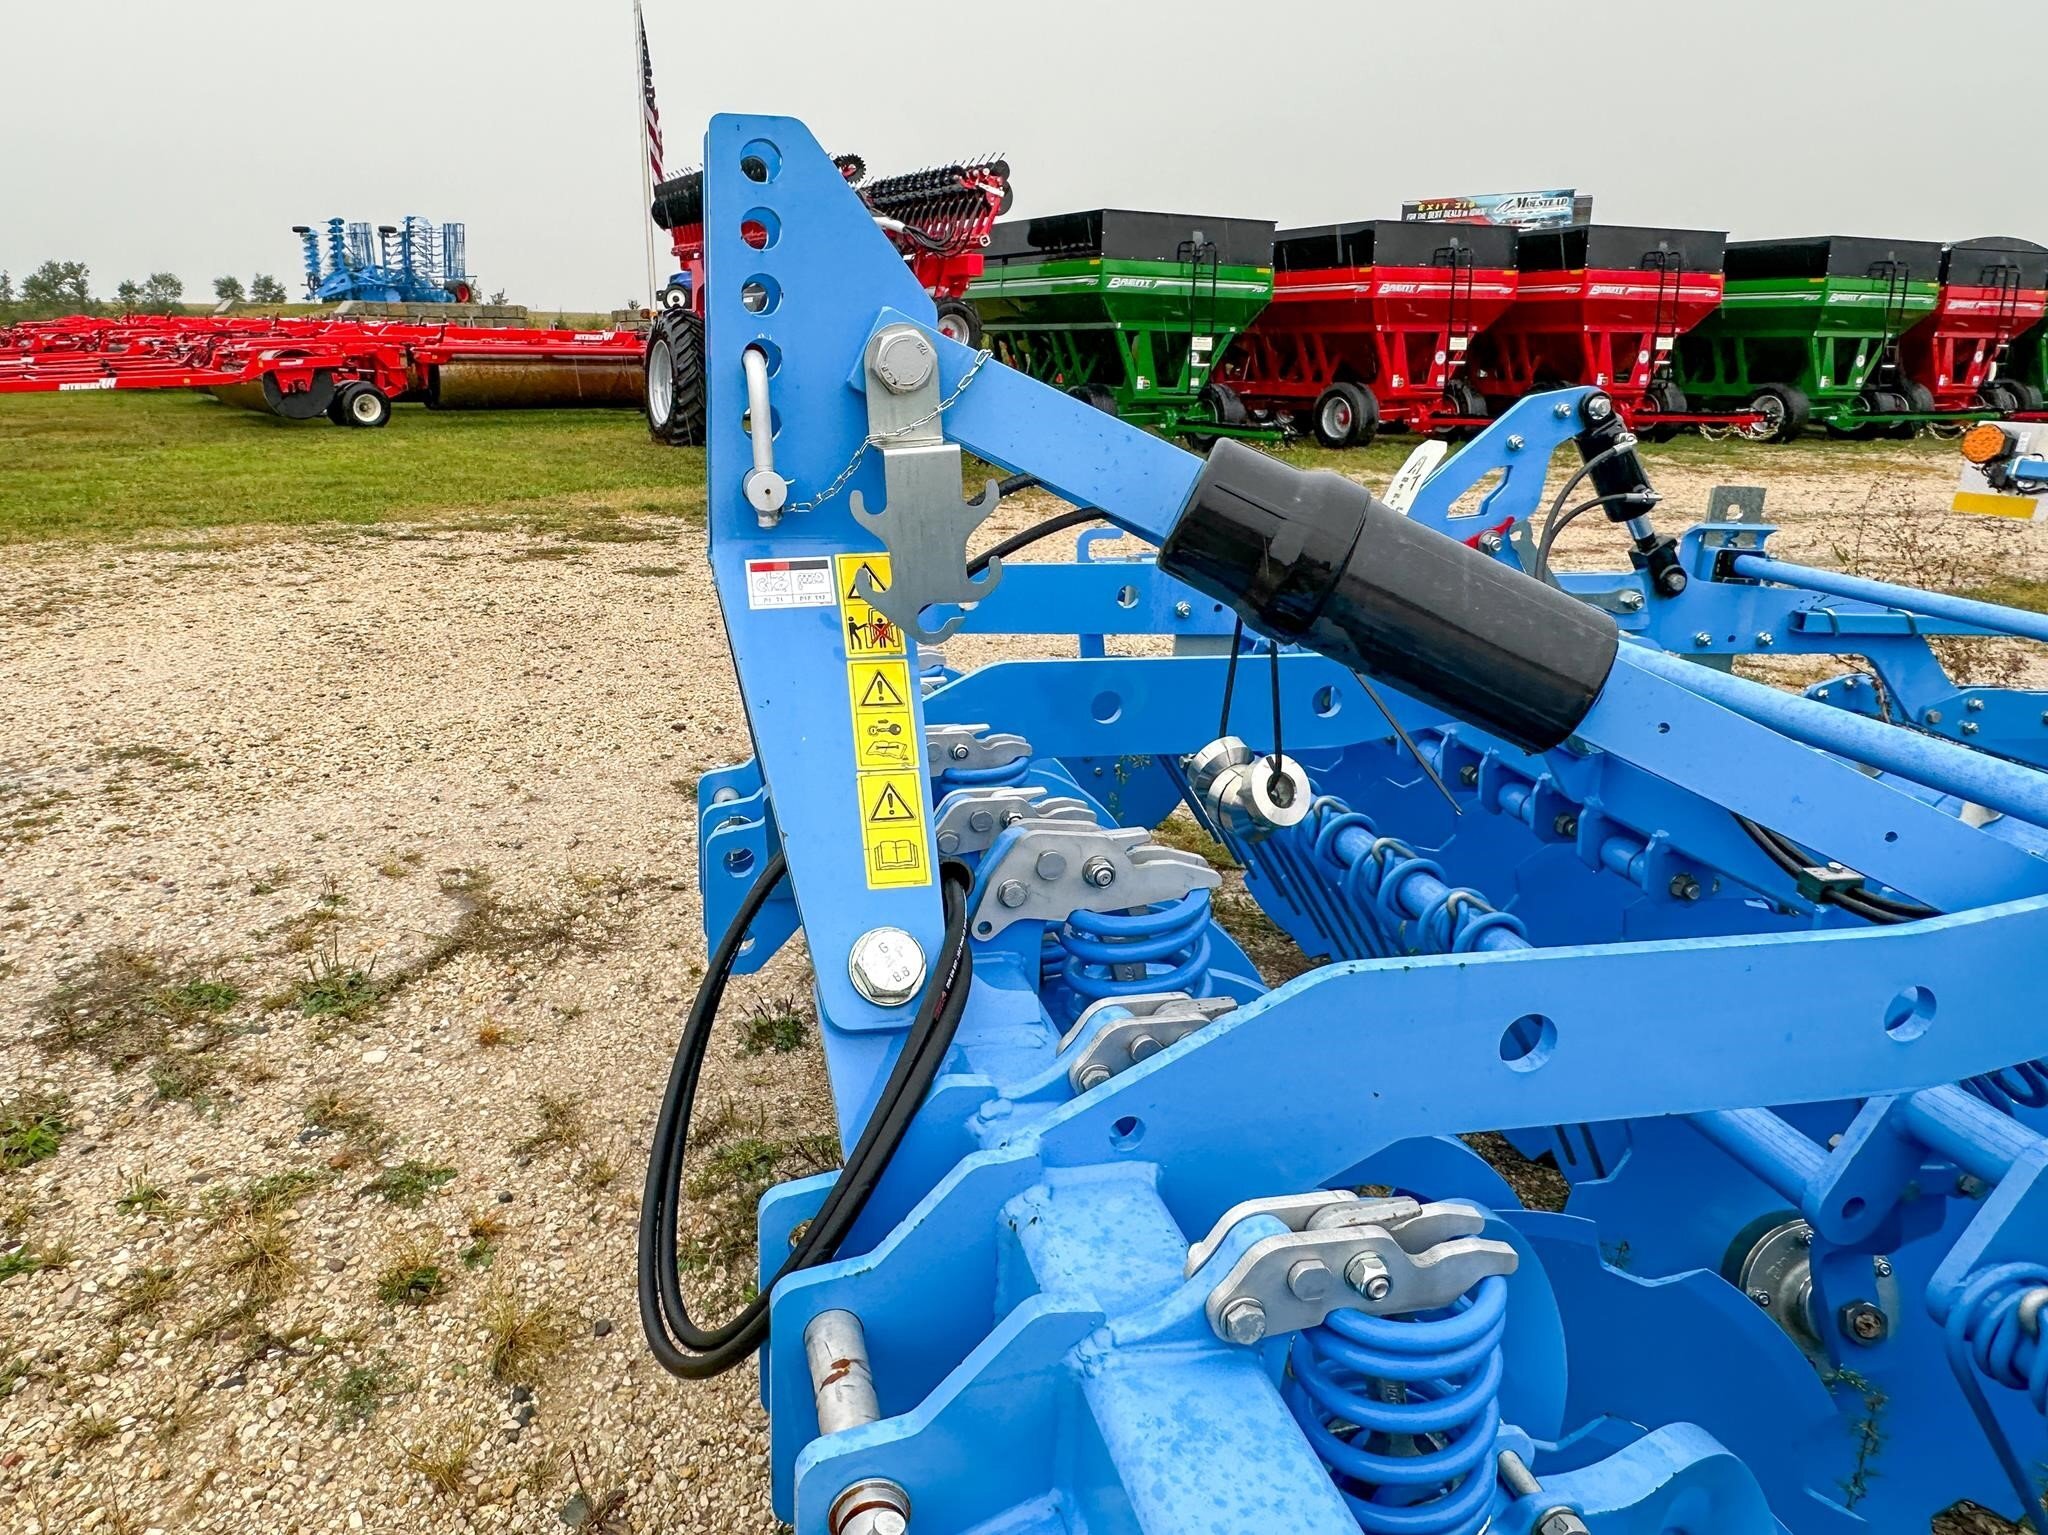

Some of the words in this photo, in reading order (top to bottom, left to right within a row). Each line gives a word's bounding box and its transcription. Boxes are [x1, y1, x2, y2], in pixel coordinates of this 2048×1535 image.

[1418, 202, 1448, 211] EXIT
[1106, 278, 1152, 288] BRENT
[878, 942, 888, 953] G
